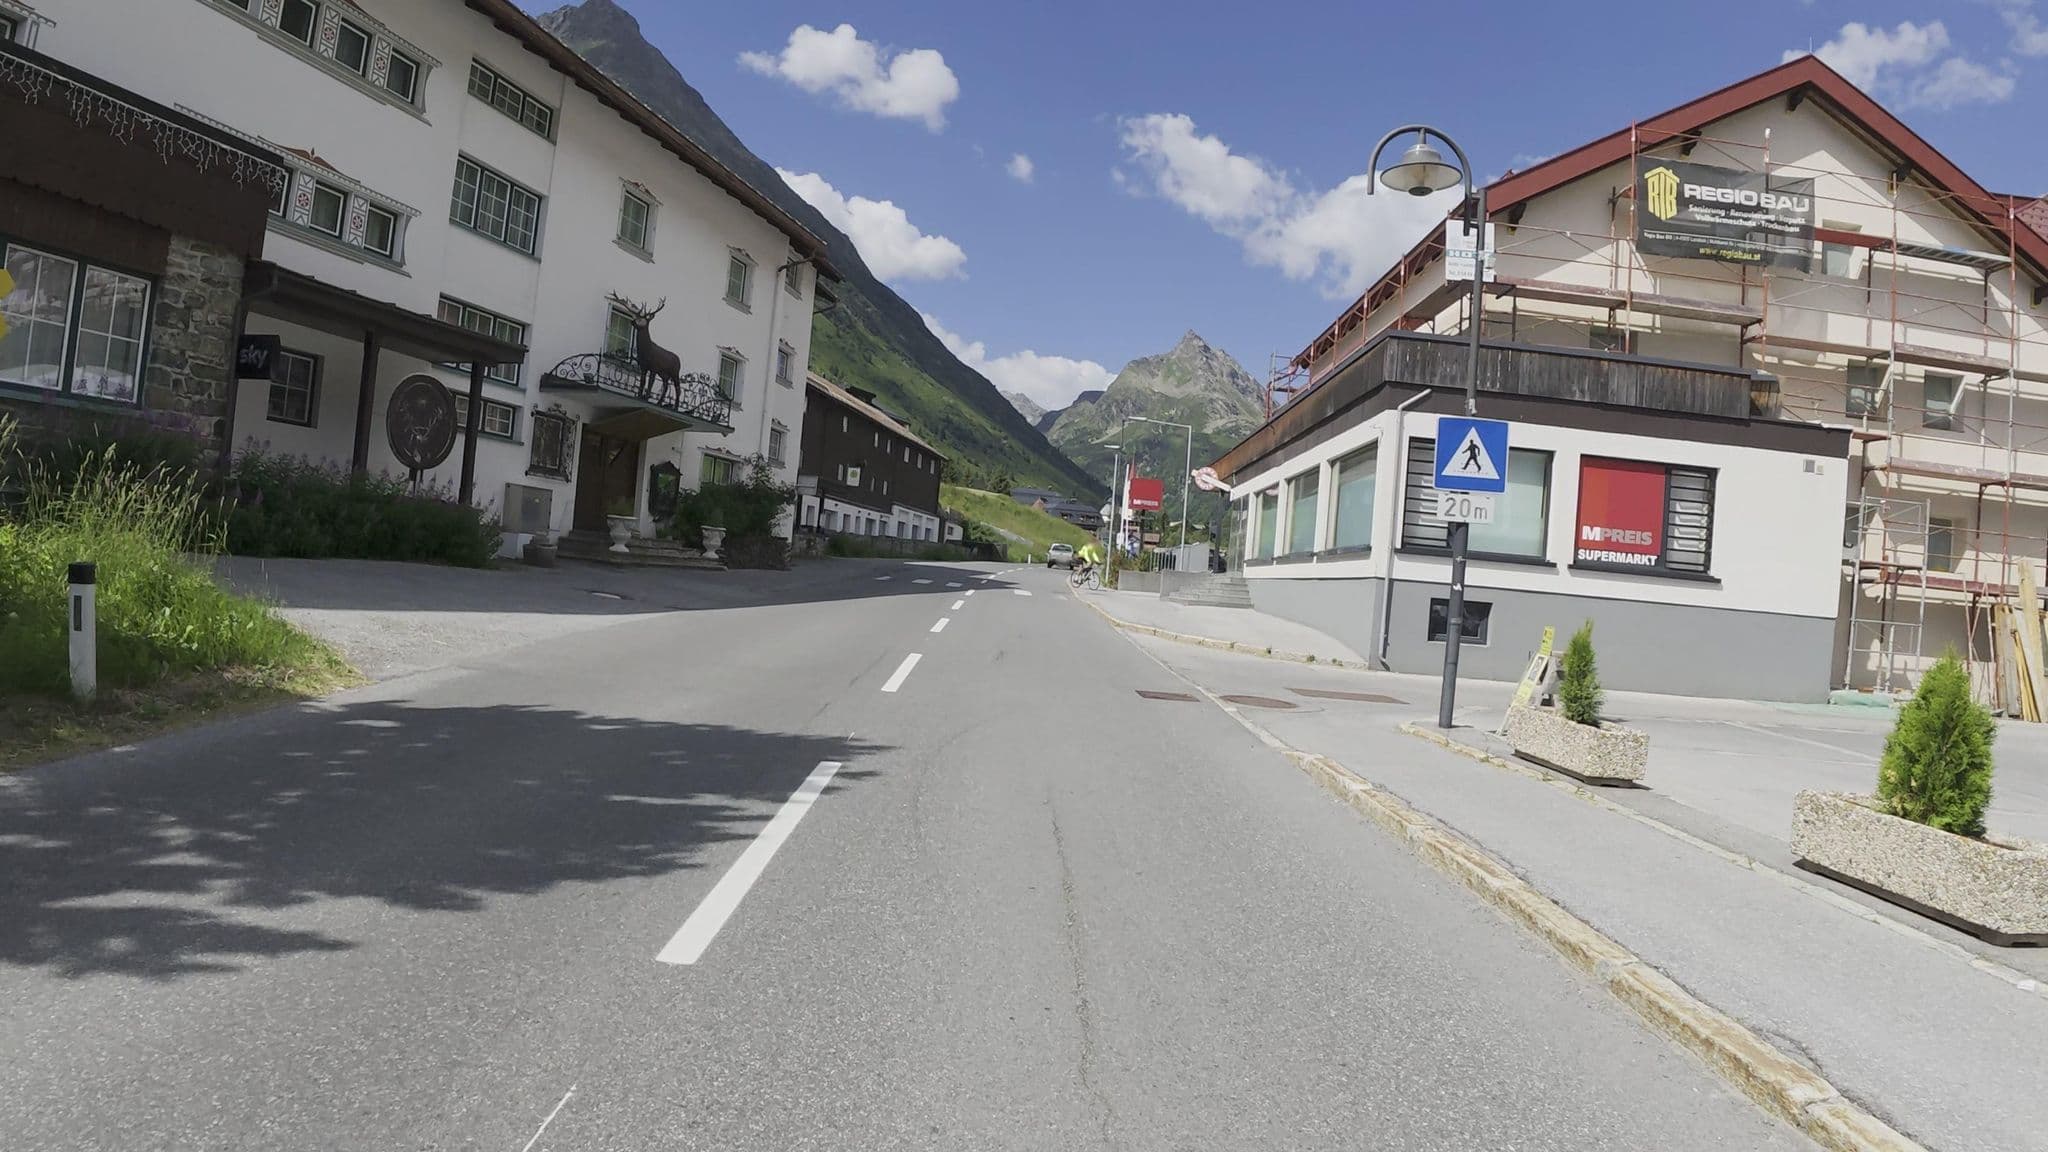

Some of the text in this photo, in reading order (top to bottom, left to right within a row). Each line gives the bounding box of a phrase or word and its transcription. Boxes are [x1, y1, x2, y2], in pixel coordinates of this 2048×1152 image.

[1684, 184, 1809, 212] REGIO BAU
[1688, 203, 1726, 217] Sanierung
[239, 344, 268, 369] sky
[1582, 525, 1653, 546] MPREIS
[1578, 549, 1658, 566] SUPERMARKT
